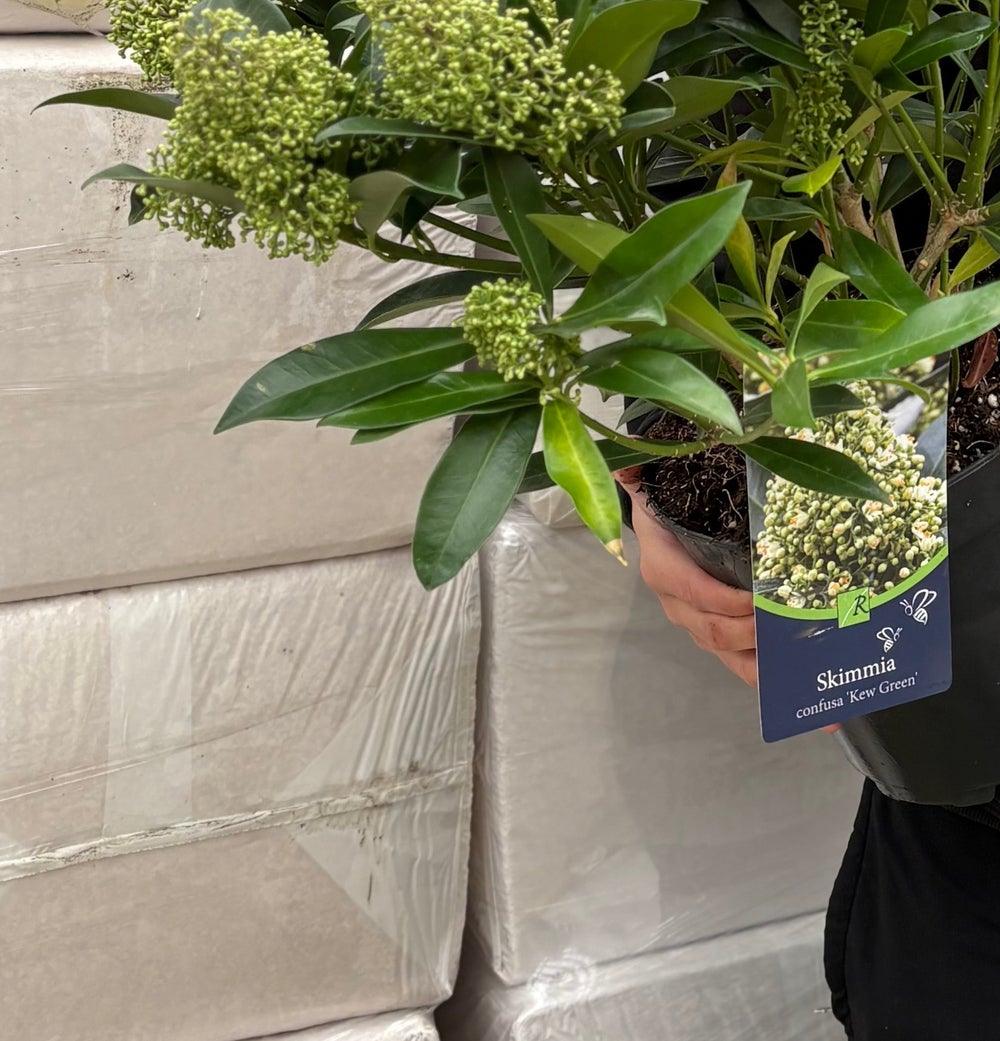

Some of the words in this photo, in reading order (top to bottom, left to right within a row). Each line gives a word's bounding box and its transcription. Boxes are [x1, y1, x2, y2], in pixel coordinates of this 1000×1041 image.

[796, 698, 845, 719] confusa
[846, 687, 877, 703] 'Kew
[879, 671, 919, 694] Green'
[816, 656, 897, 692] Skimmia
